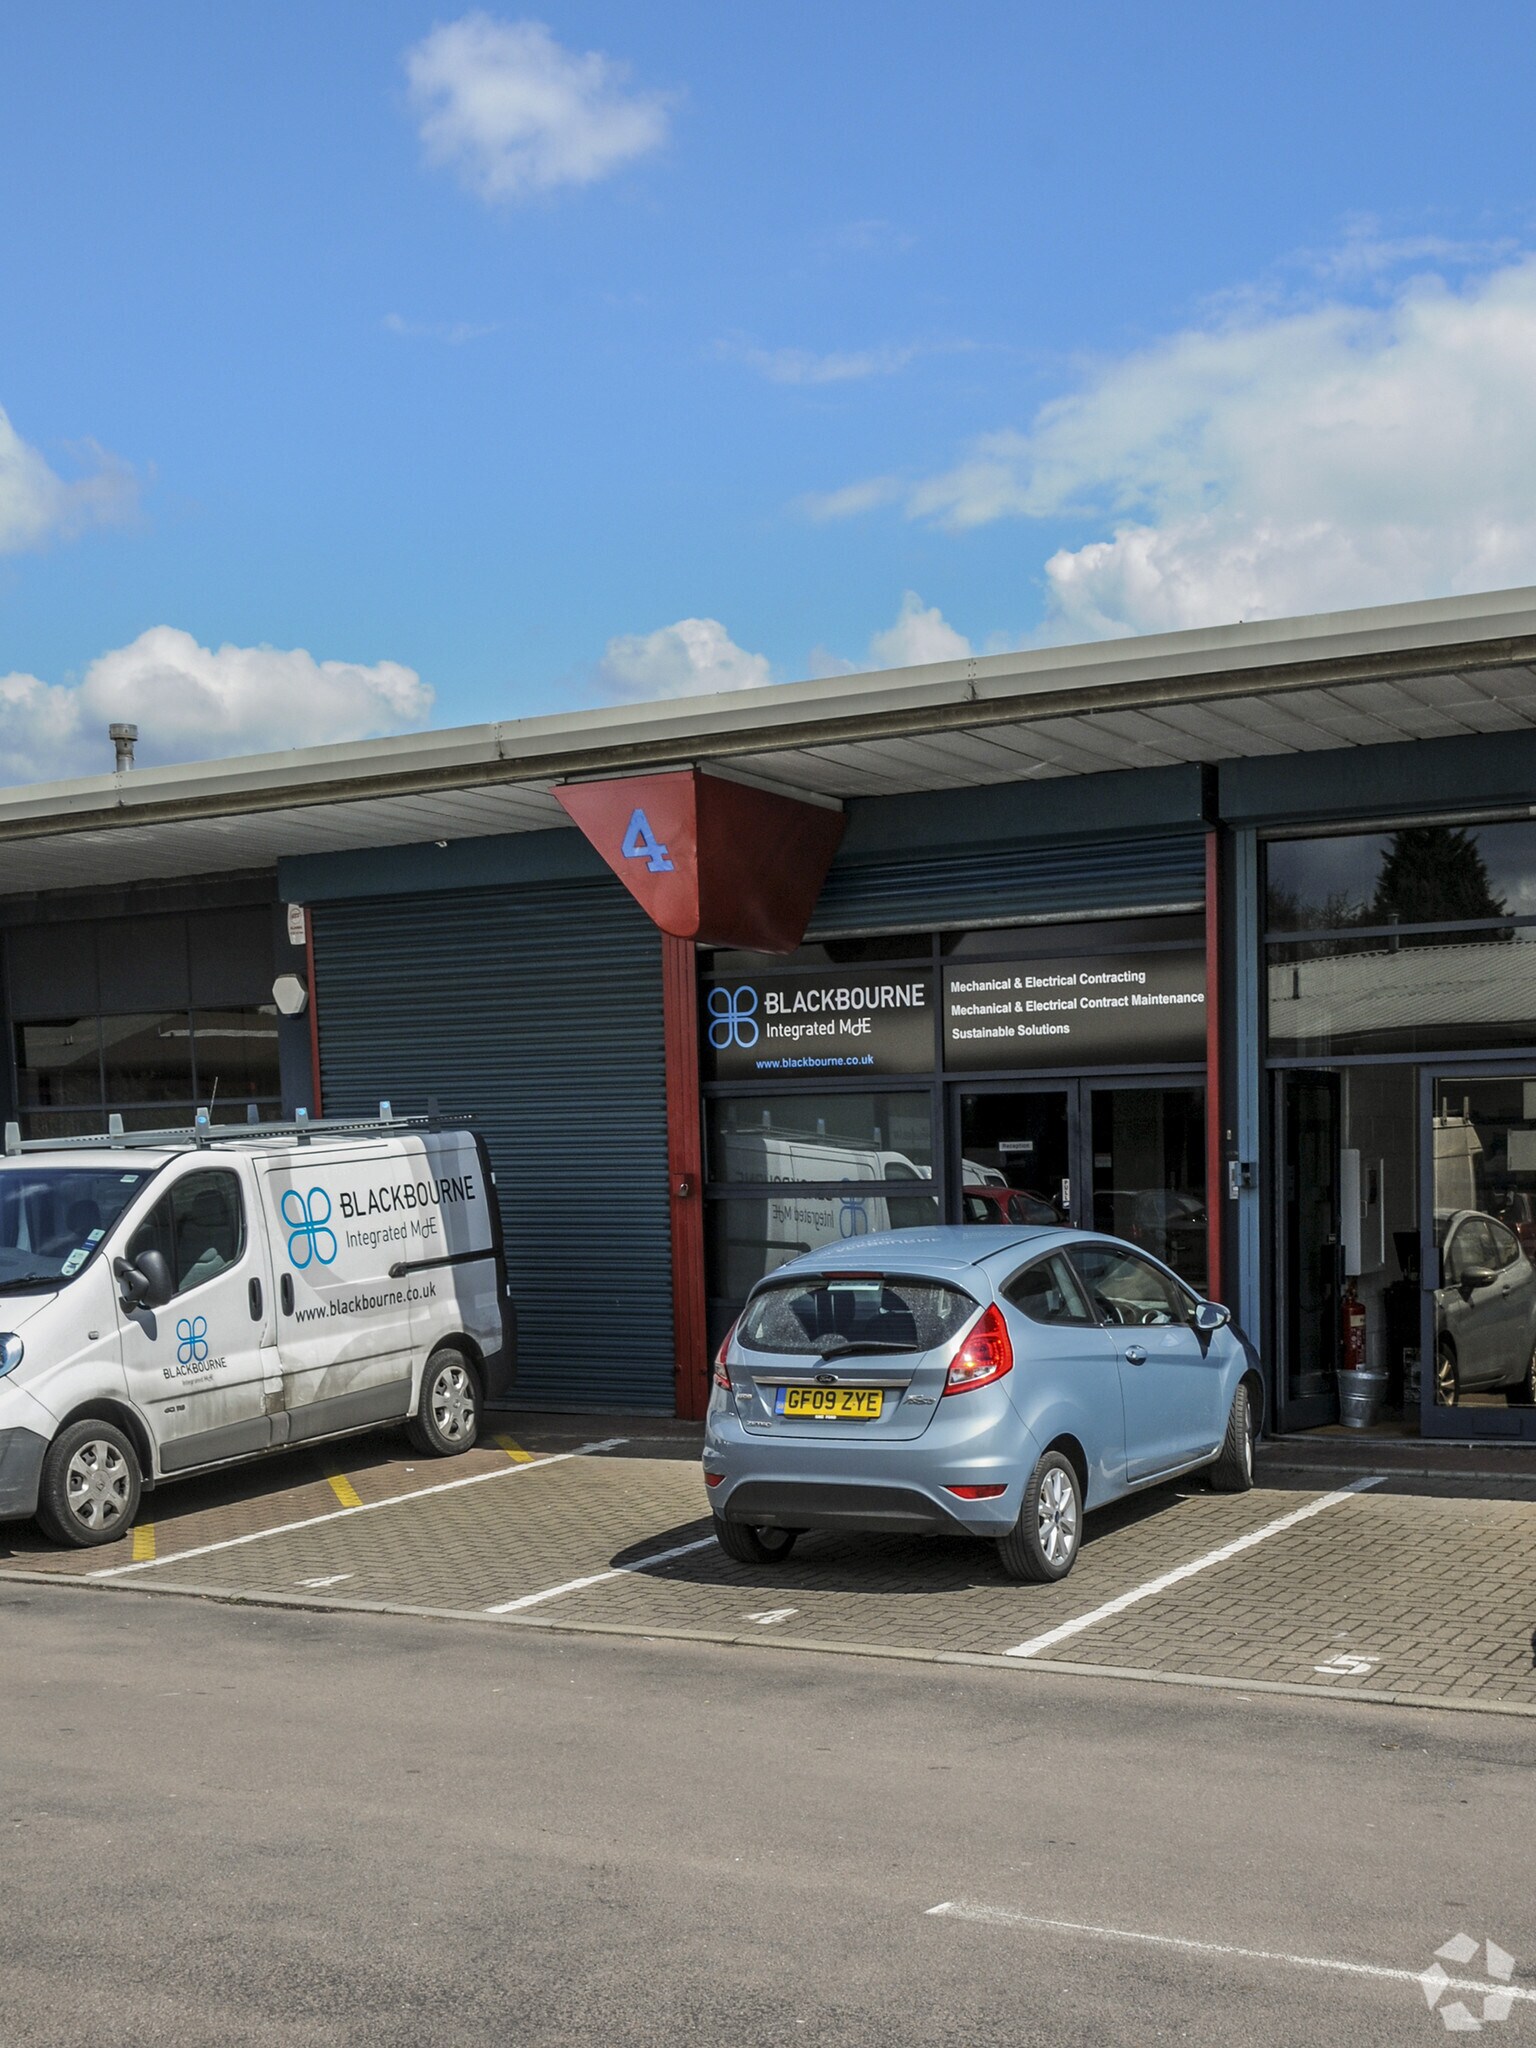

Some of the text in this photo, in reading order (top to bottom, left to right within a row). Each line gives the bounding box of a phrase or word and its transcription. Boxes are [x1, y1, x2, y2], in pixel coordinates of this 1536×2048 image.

[621, 808, 675, 873] 4
[950, 970, 1146, 992] Mechanical & Electrical Contracting
[764, 984, 925, 1014] BLACKBOURNE
[951, 992, 1205, 1016] Mechanical & Electrical Contract Maintenance
[766, 1020, 835, 1040] Integrated
[951, 1023, 1071, 1039] Sustainable Solutions
[755, 1054, 875, 1069] www.blackbourne.co.uk
[339, 1175, 476, 1219] BLACKBOURNE
[346, 1221, 407, 1249] Integrated
[295, 1281, 437, 1323] www.blackbourne.co.uk
[162, 1357, 228, 1380] BLACKBOURNE
[788, 1390, 879, 1411] GF09 ZYE
[1314, 1654, 1380, 1675] 5
